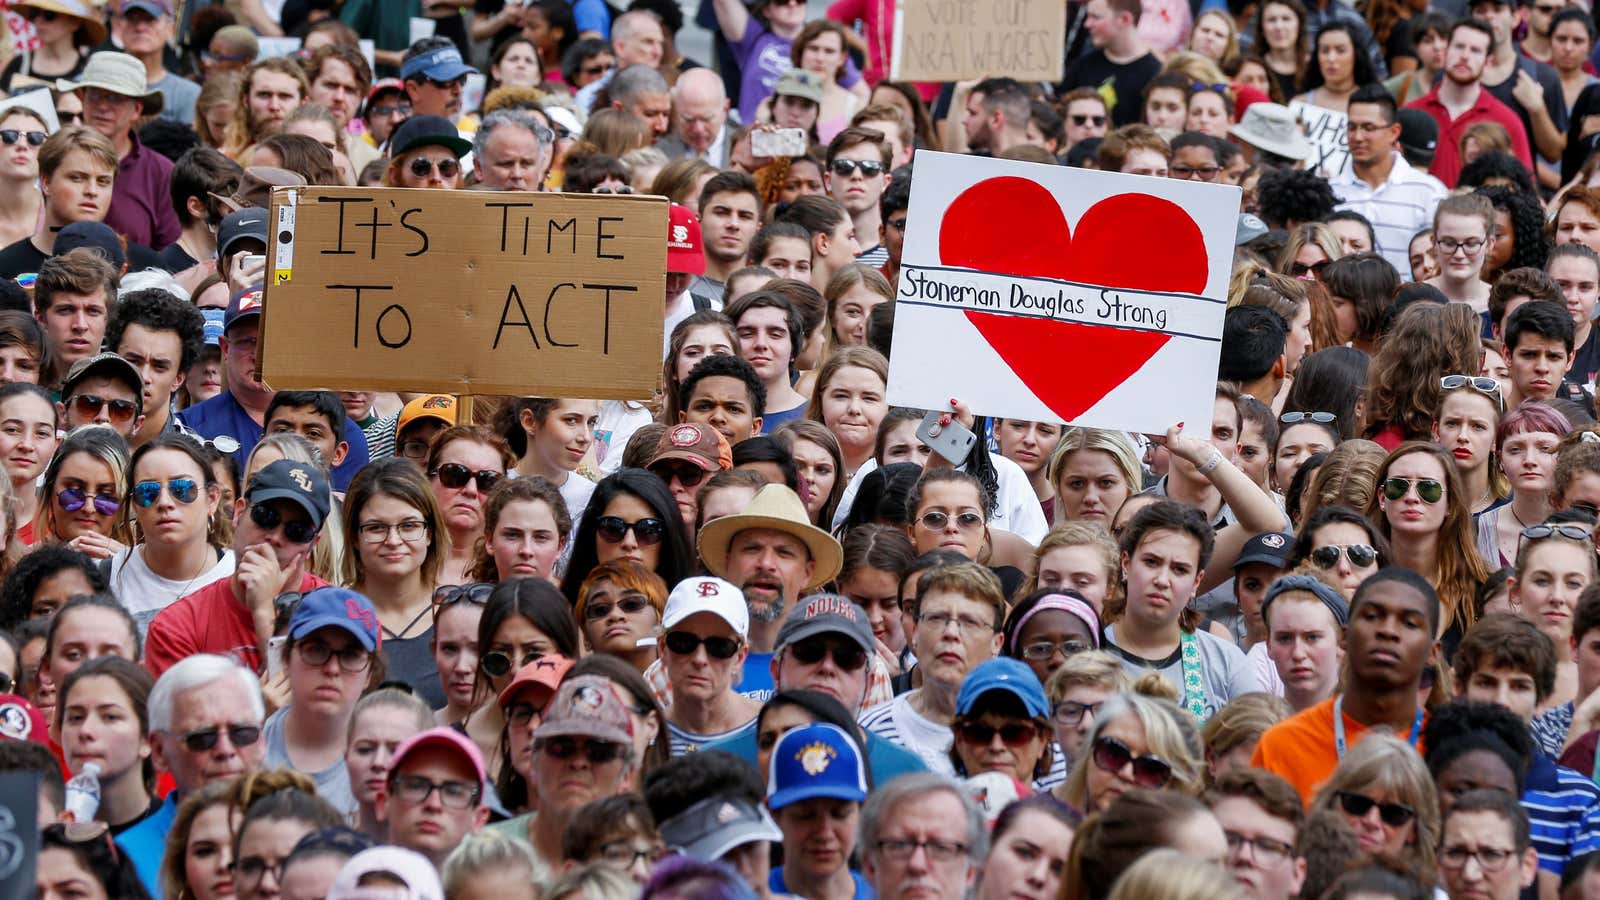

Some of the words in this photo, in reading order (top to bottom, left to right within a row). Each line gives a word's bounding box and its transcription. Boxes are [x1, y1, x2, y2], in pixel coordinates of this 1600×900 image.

[925, 0, 978, 27] VOTE
[992, 0, 1033, 27] OUT
[904, 30, 958, 72] NRA
[967, 29, 1051, 72] WHORES
[485, 203, 624, 260] TIME
[493, 283, 638, 355] ACT
[900, 268, 1001, 308] Stoneman
[1009, 283, 1085, 318] Douglas
[1097, 289, 1167, 329] Strong
[804, 597, 857, 623] NOLES
